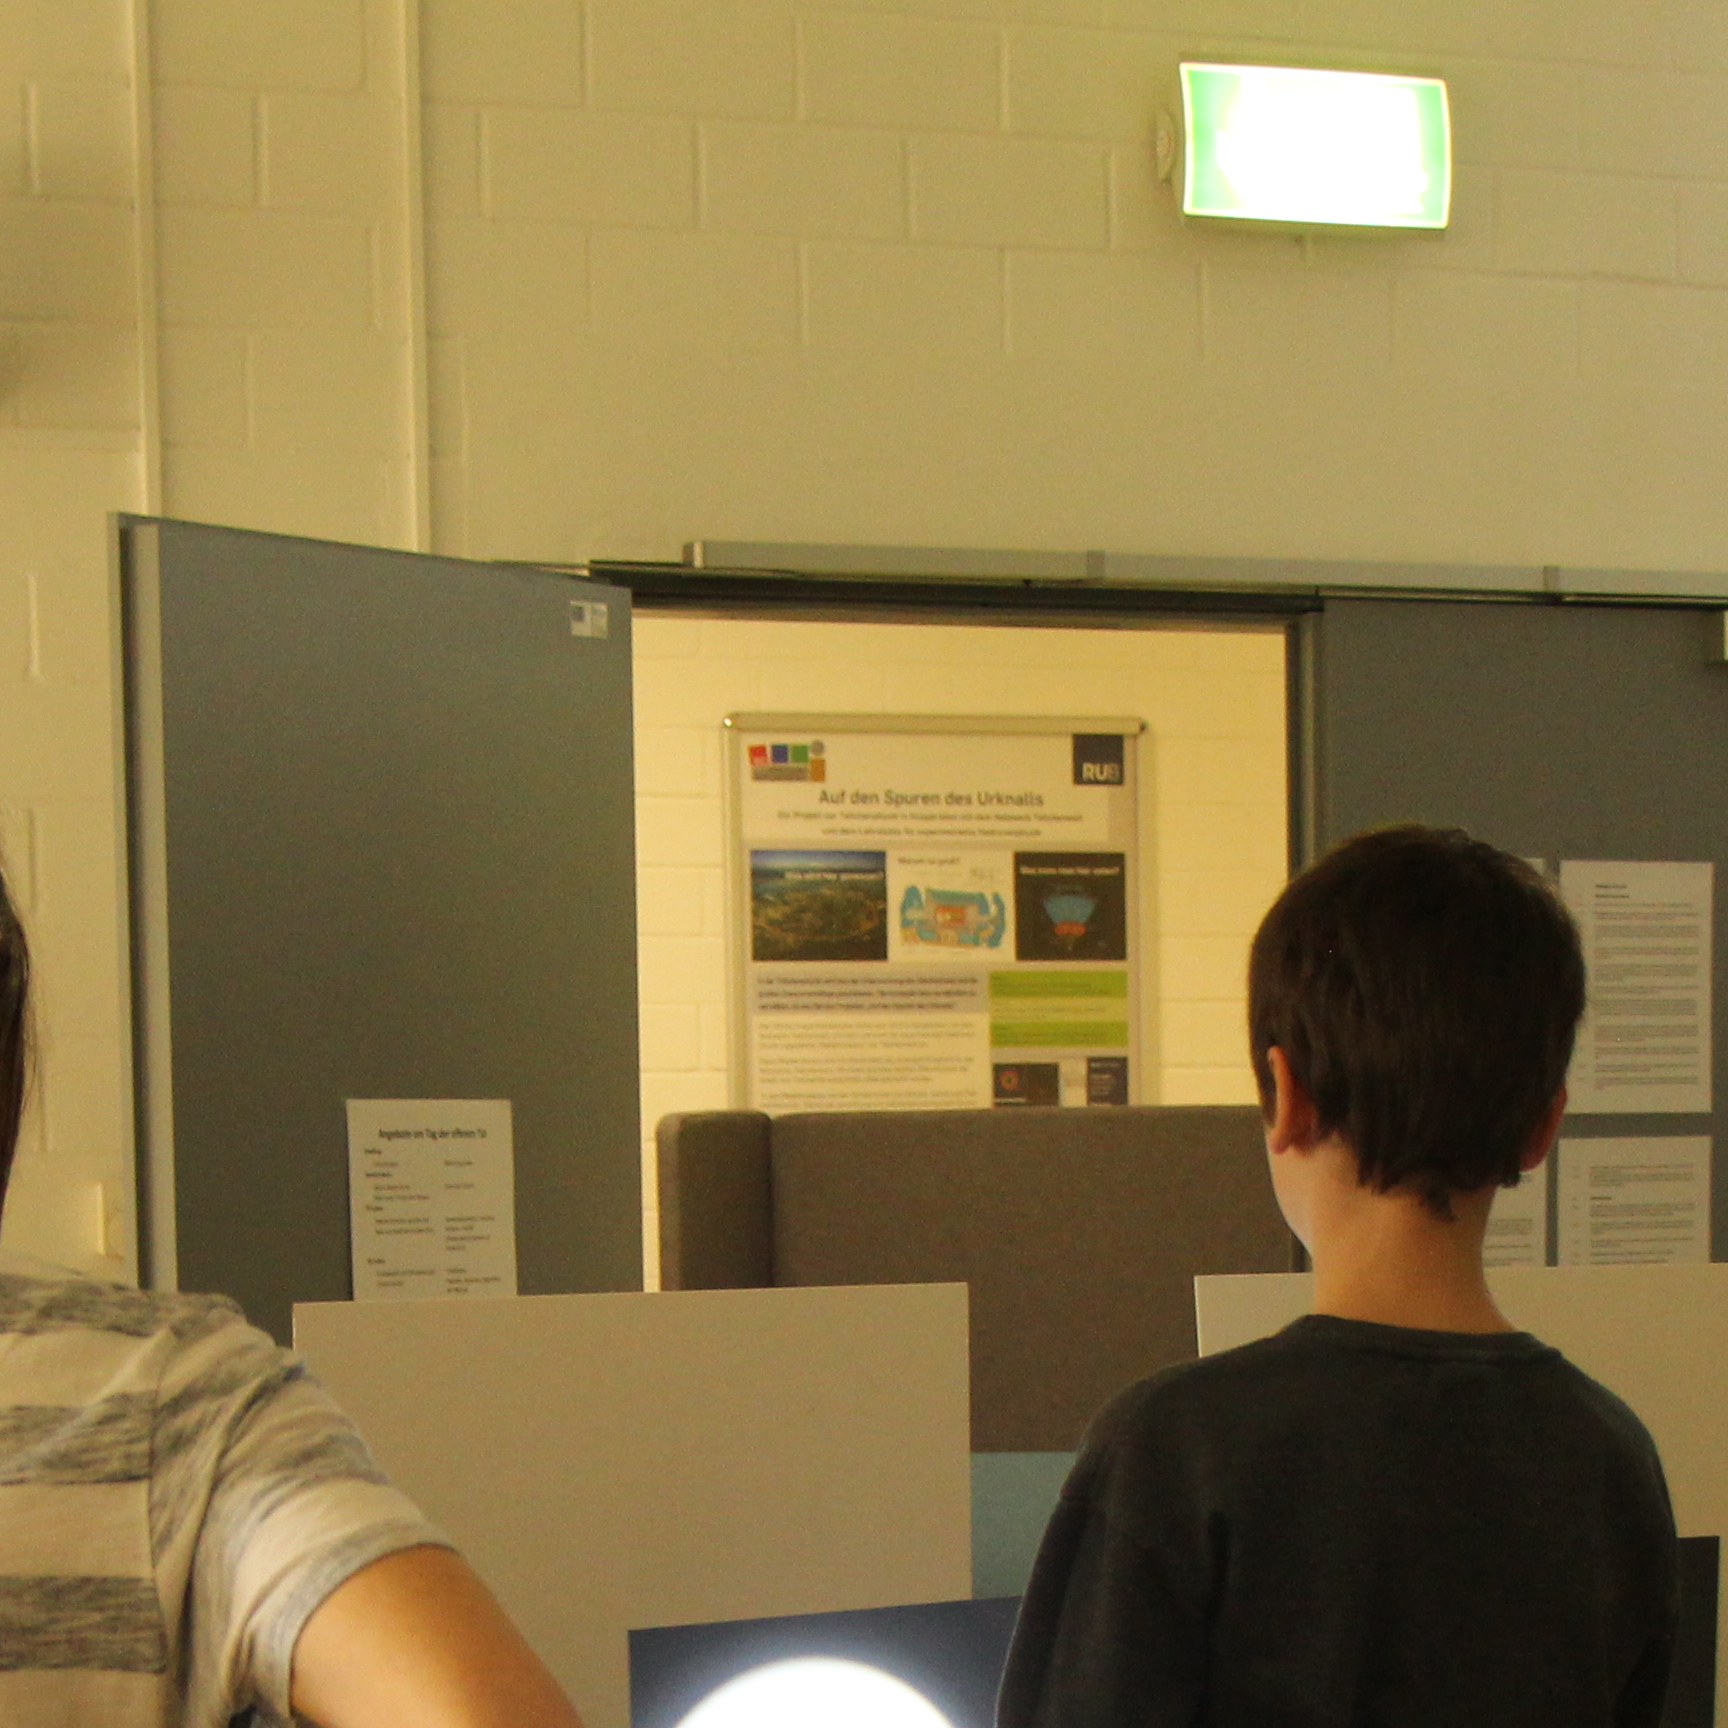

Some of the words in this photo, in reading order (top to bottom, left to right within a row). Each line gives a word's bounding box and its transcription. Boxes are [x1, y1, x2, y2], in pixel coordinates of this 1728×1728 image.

[1082, 762, 1121, 782] RUB
[819, 788, 846, 804] Auf
[850, 789, 879, 805] den
[884, 788, 941, 807] Spuren
[944, 791, 973, 806] des
[977, 791, 1044, 807] Urknalls
